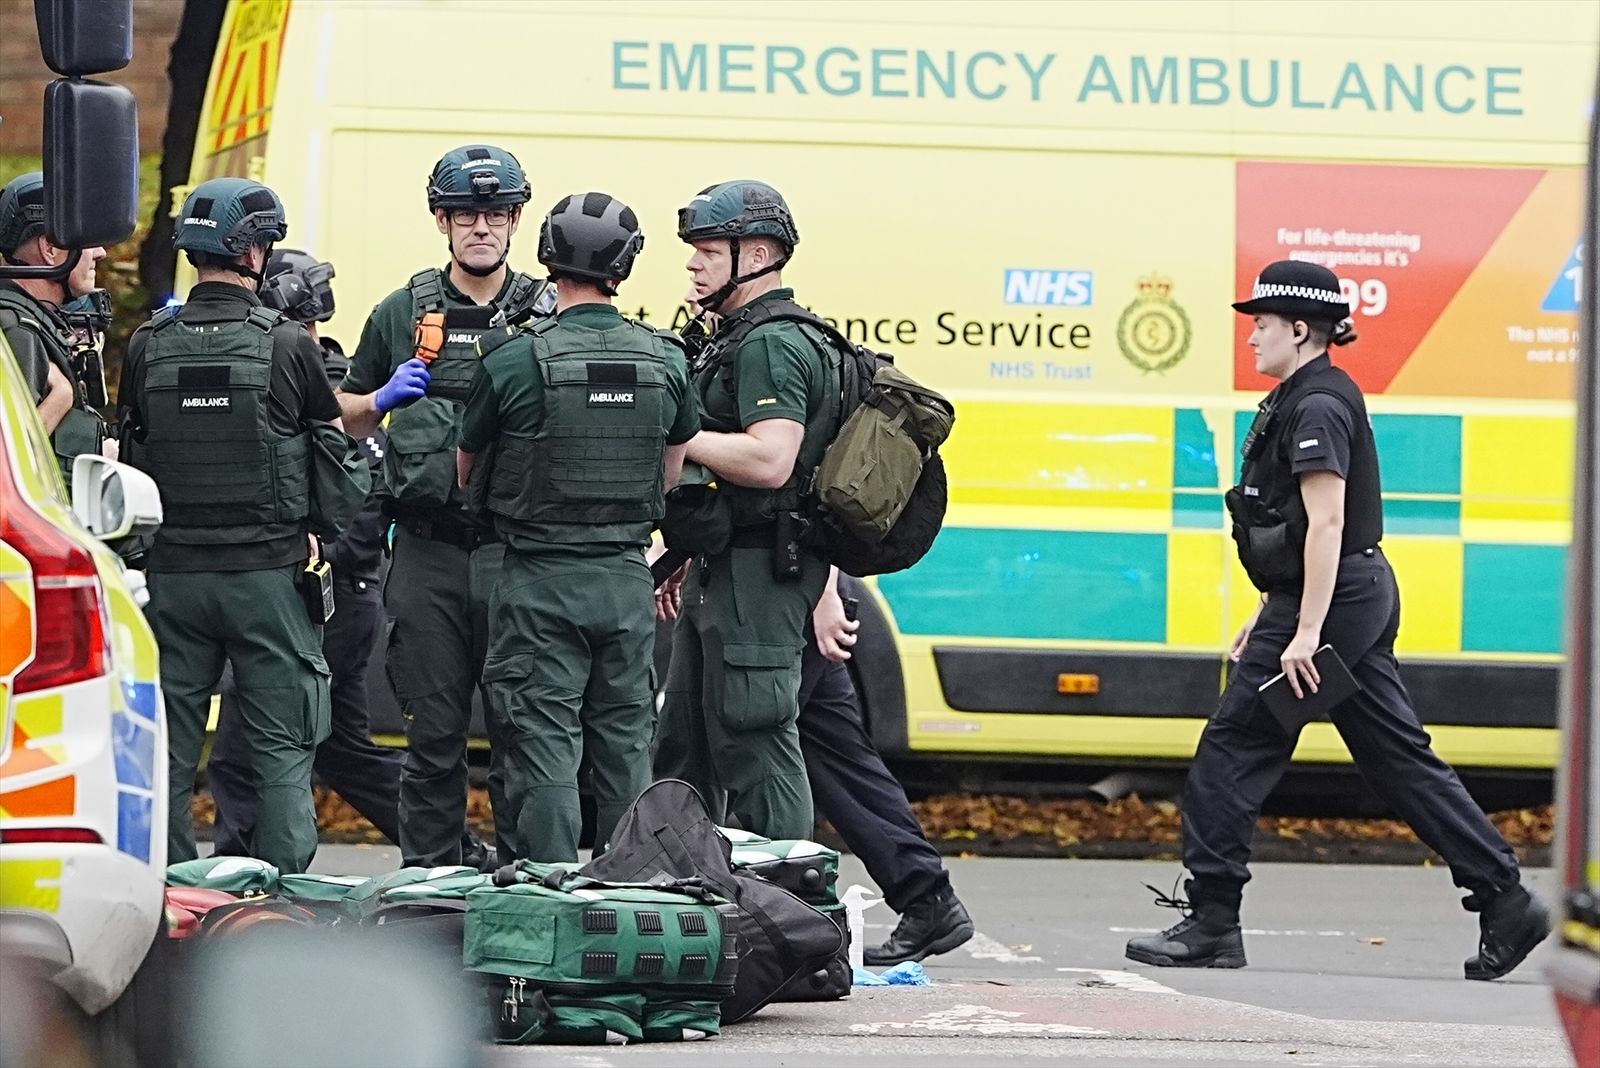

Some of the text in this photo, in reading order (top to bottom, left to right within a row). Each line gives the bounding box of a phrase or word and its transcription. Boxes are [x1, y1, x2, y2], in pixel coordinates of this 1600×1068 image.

[612, 40, 1525, 116] EMERGENCY AMBULANCE
[1277, 227, 1421, 252] For life-threatening
[1004, 270, 1092, 305] NHS
[936, 311, 1092, 350] Service
[1506, 325, 1535, 342] The
[1536, 327, 1570, 343] NHS
[989, 361, 1092, 380] NHS Trust
[181, 397, 230, 408] AMBULANCE
[588, 392, 634, 403] AMBULANCE
